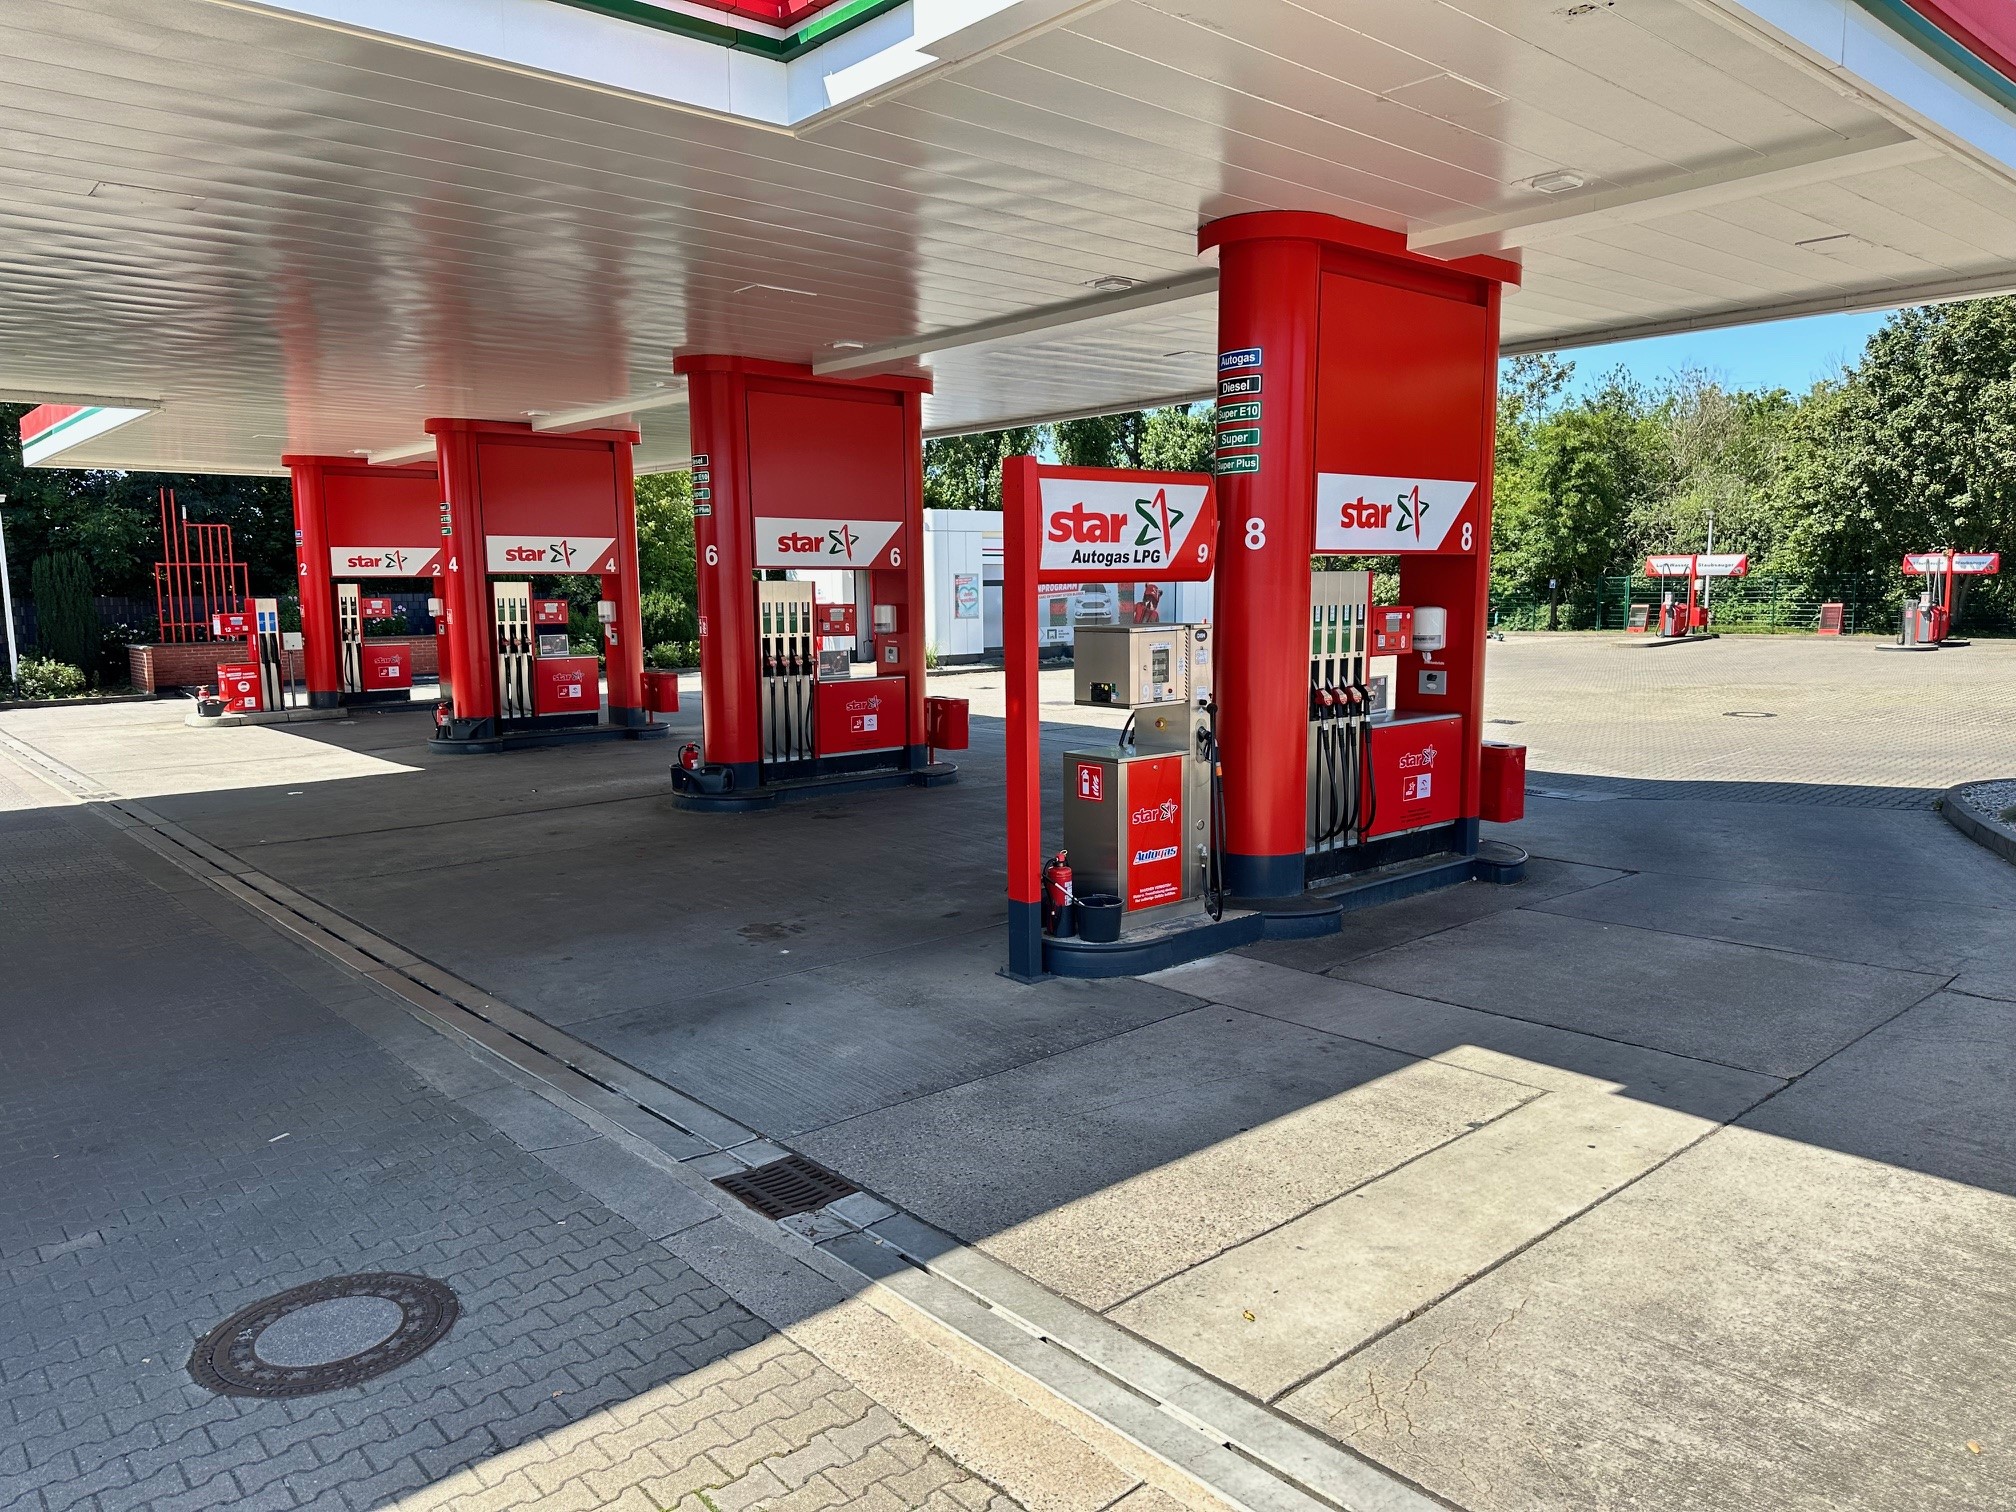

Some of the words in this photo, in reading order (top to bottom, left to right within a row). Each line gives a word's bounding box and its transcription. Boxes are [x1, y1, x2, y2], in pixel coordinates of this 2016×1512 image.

[1221, 353, 1256, 366] Autogas
[1222, 380, 1250, 393] Diesel
[1239, 405, 1258, 416] E10
[1221, 432, 1249, 445] Super
[1236, 458, 1256, 468] Plus
[1340, 496, 1392, 529] star
[1048, 502, 1128, 543] star
[1245, 517, 1266, 550] 8
[1461, 521, 1473, 551] 8
[778, 532, 824, 553] star
[348, 555, 382, 567] star
[505, 545, 546, 562] star
[705, 544, 719, 566] 6
[890, 547, 901, 567] 6
[1071, 549, 1130, 566] Autogas
[1133, 549, 1161, 563] LPG
[1197, 543, 1209, 563] 9
[300, 563, 307, 575] 2
[432, 563, 441, 575] 2
[448, 556, 459, 572] 4
[605, 557, 616, 572] 4
[845, 623, 850, 632] 6
[1401, 635, 1406, 649] 8
[1142, 684, 1150, 700] 9
[846, 700, 867, 711] star
[1400, 753, 1422, 769] star
[1132, 808, 1159, 825] star
[1136, 846, 1176, 863] Autogas
